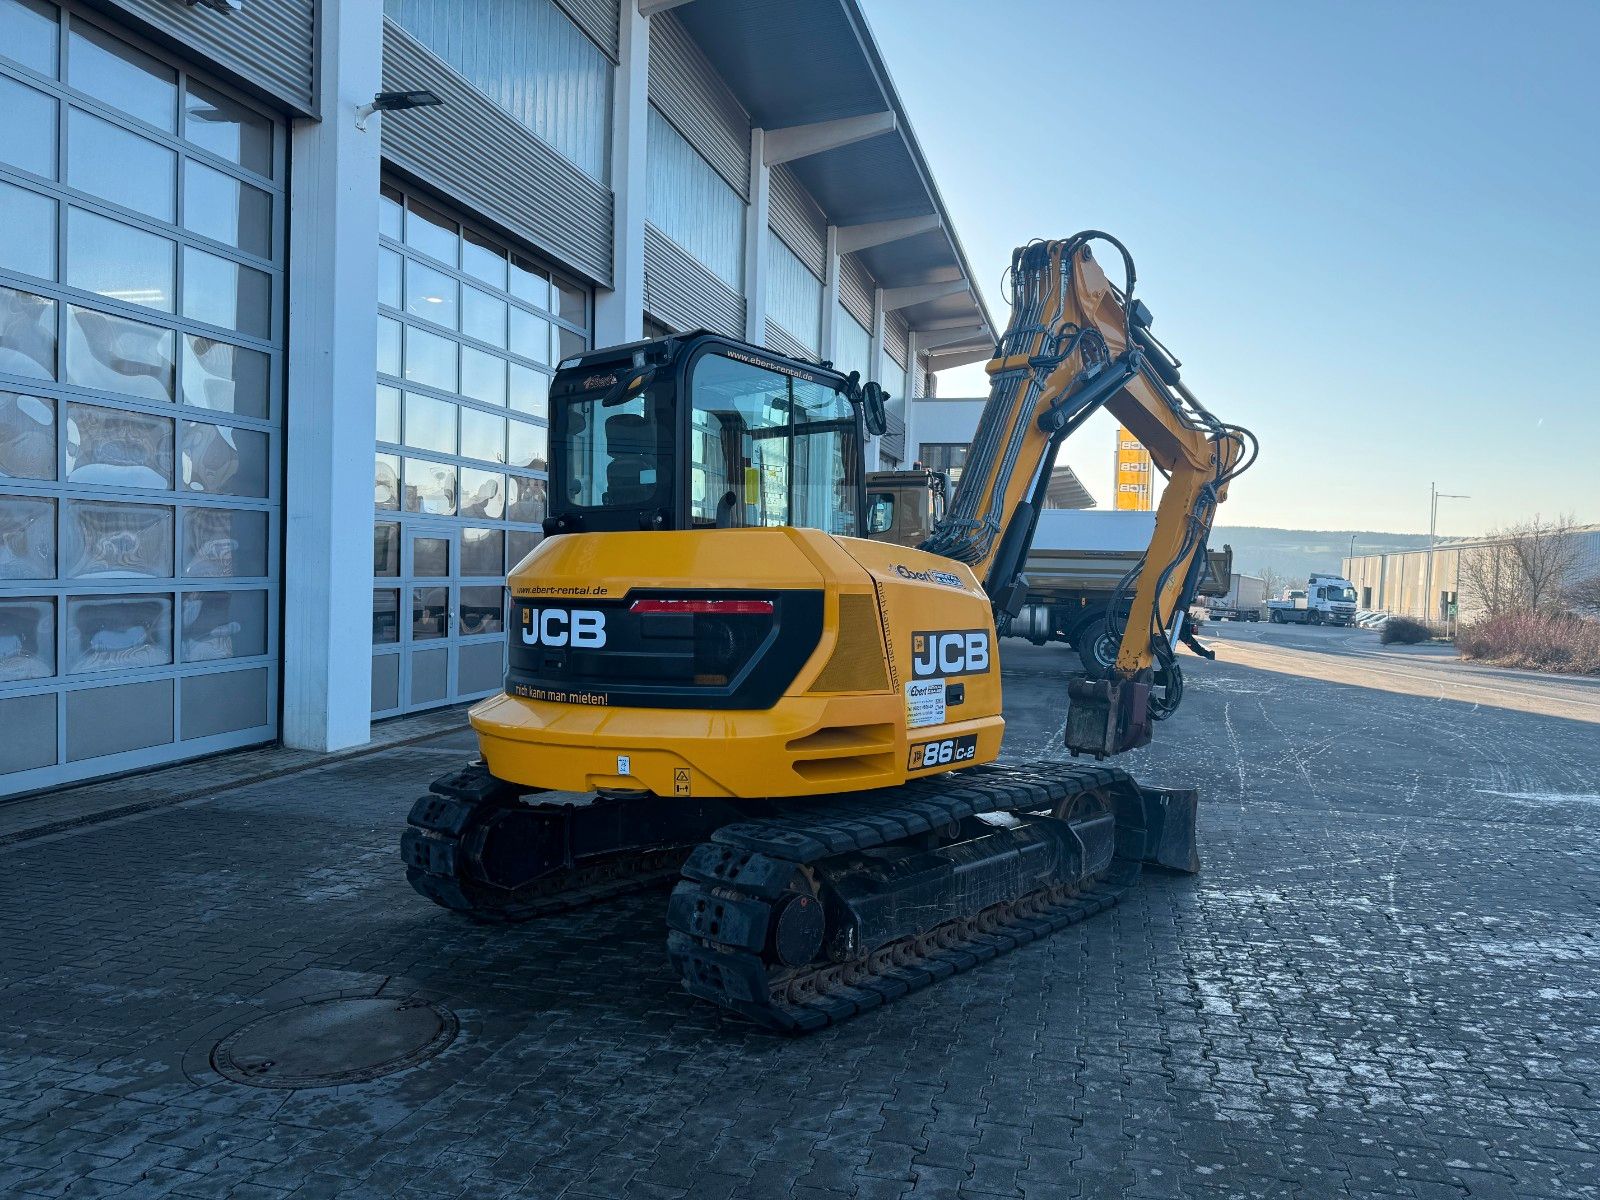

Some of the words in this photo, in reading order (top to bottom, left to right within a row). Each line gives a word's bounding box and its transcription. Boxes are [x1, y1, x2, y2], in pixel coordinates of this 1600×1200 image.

[727, 350, 813, 381] www.ebert-rental.de
[516, 585, 608, 596] www.ebert-rental.de
[522, 608, 607, 648] JCB
[882, 609, 891, 637] kann
[886, 638, 895, 662] man
[914, 633, 989, 676] JCB
[529, 685, 546, 699] kann
[547, 690, 567, 702] man
[569, 691, 608, 706] mieten!
[923, 740, 954, 766] 86
